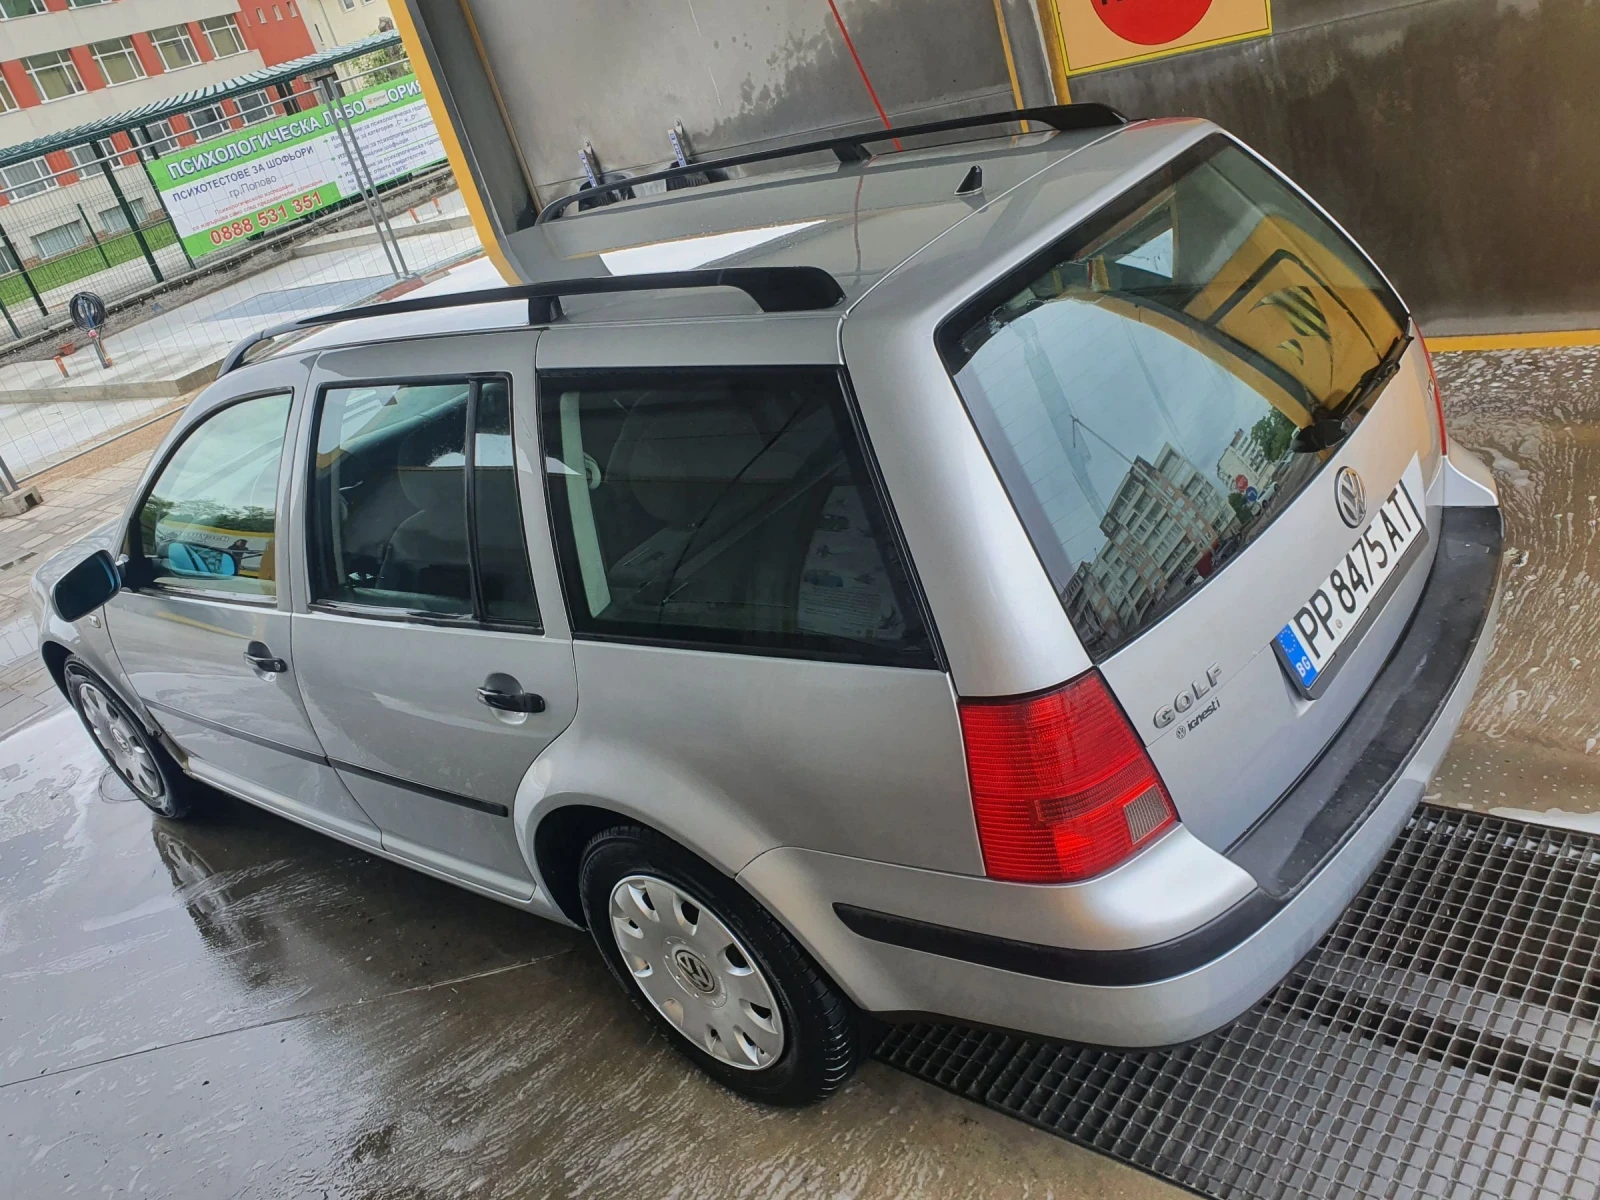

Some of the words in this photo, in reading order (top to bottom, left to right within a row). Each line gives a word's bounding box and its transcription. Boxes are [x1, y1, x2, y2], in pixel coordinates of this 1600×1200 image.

[166, 116, 323, 180] ПСИХОЛОГИЧЕСКА
[322, 79, 422, 127] ЛАБООРИ
[172, 164, 251, 202] ПСИХОТЕСТОВЕ
[252, 161, 266, 177] ЗА
[266, 145, 314, 169] ШОФЬОРИ
[229, 175, 277, 199] гр.Попово
[210, 217, 254, 246] 0888
[257, 204, 288, 227] 531
[292, 190, 323, 215] 351
[1379, 487, 1412, 552] AT
[1329, 525, 1388, 614] 8475
[1293, 588, 1335, 660] PP
[1153, 661, 1222, 729] GOLF
[1296, 655, 1312, 678] BG
[1187, 696, 1220, 732] ignesti
